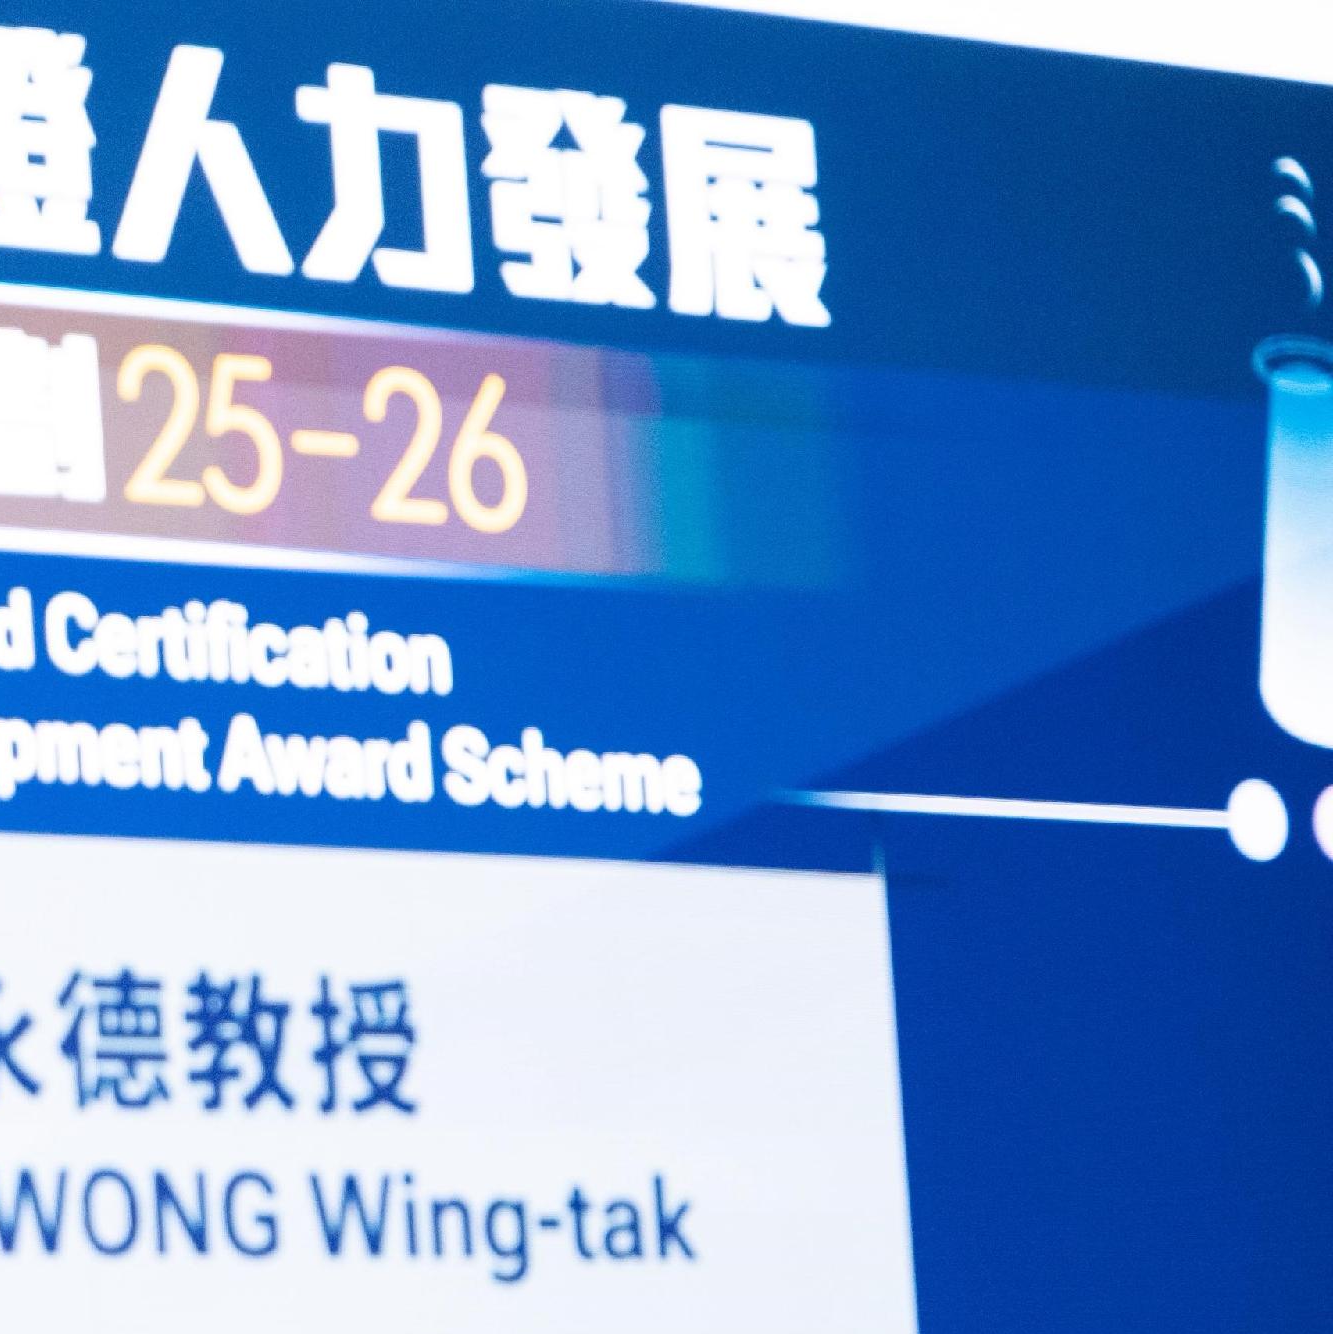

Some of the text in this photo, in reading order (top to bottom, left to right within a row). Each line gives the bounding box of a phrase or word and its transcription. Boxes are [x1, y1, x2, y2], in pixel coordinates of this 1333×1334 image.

[45, 592, 453, 696] Certification
[218, 713, 434, 802] Award
[442, 726, 701, 816] Scheme
[309, 1172, 697, 1285] Wing-tak
